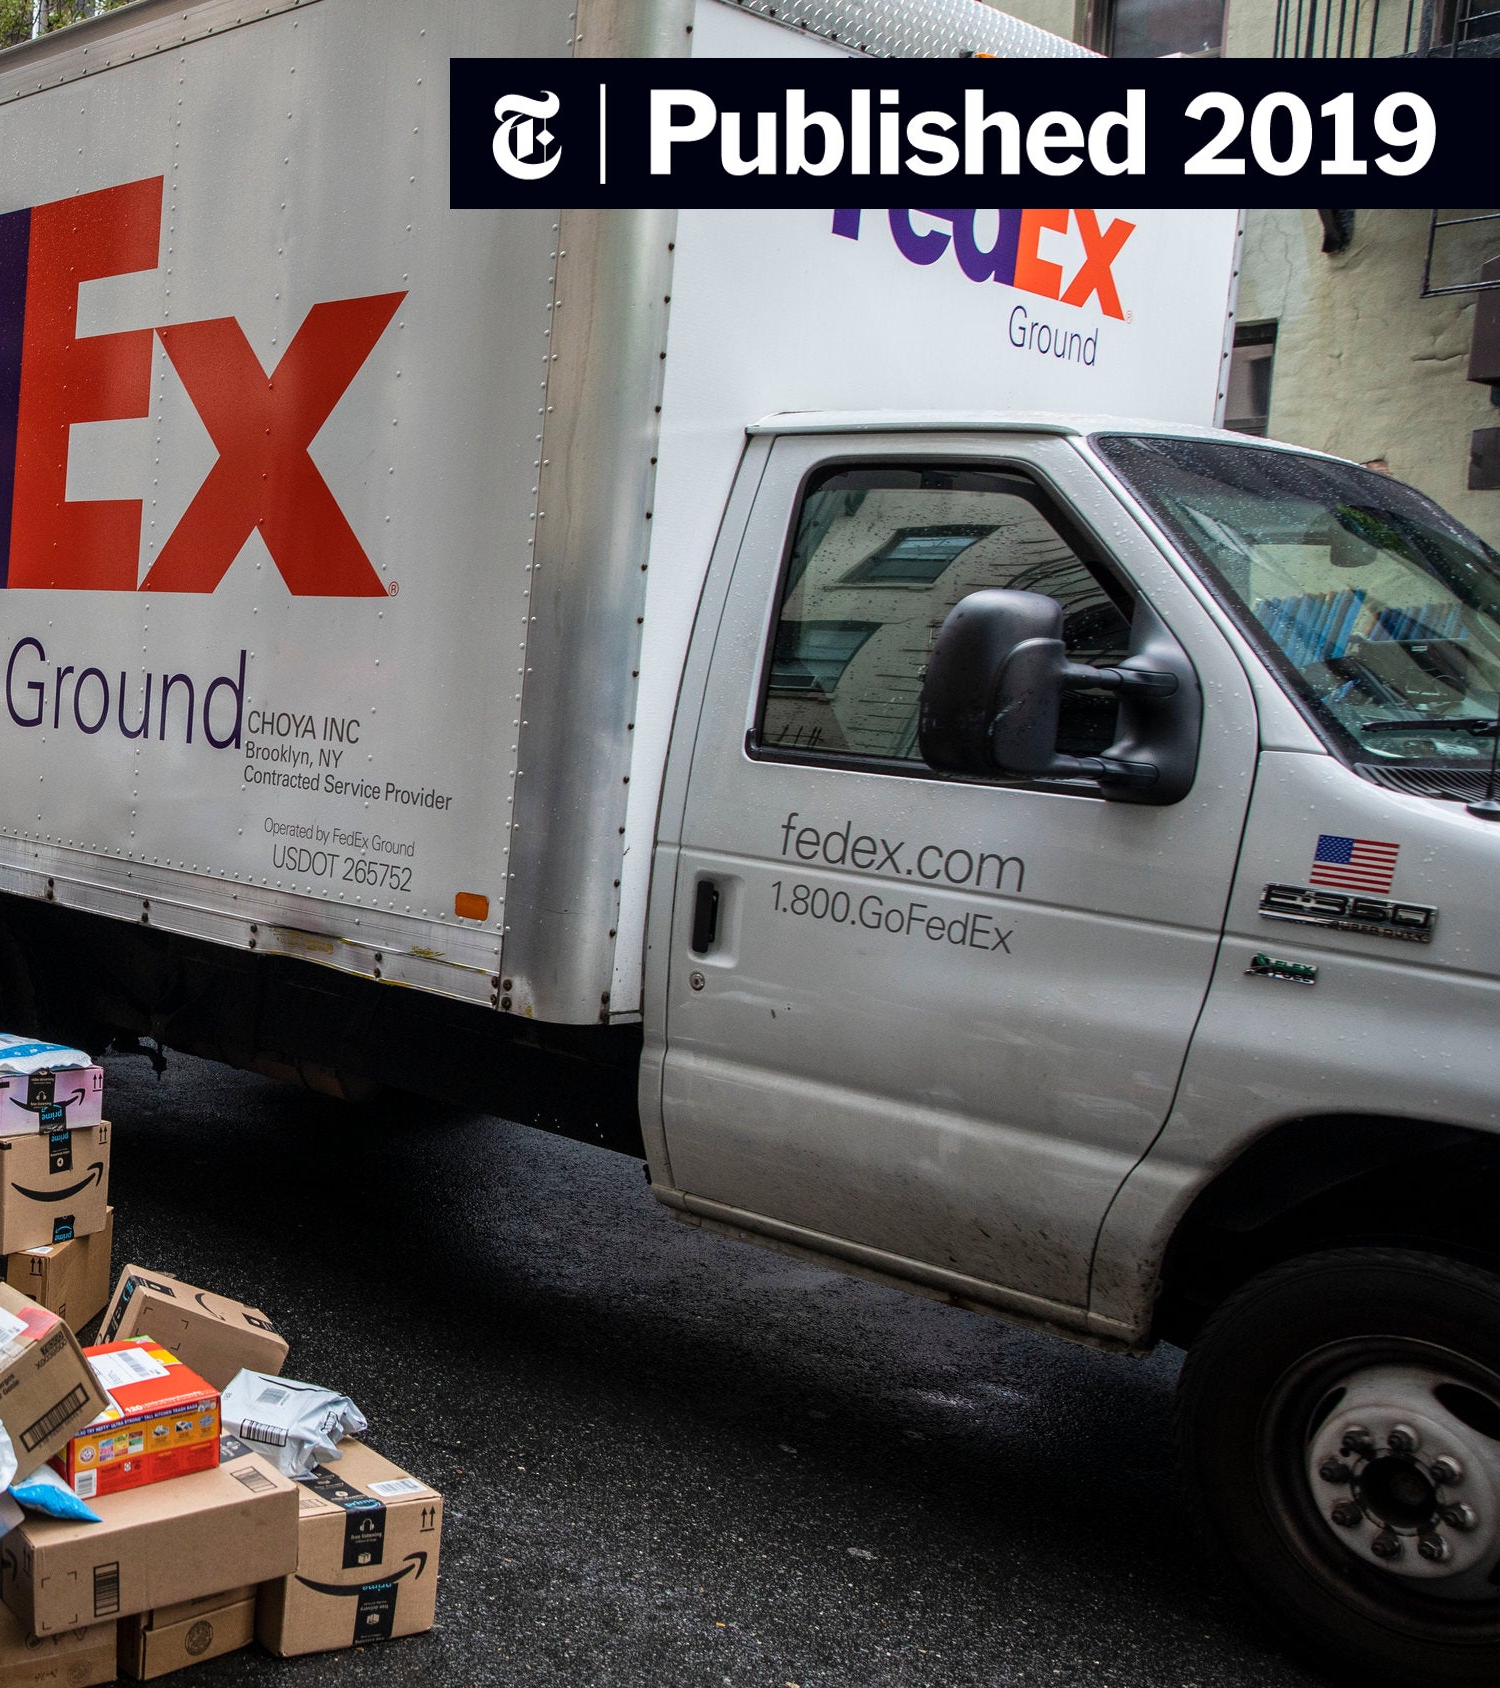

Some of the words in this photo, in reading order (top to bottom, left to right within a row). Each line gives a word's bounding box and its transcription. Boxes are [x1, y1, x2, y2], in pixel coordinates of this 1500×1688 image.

[1009, 305, 1098, 366] Ground
[6, 637, 246, 750] Ground
[247, 710, 316, 740] CHOYA
[323, 717, 361, 744] INC
[245, 741, 314, 768] Brooklyn,
[319, 749, 344, 769] NY
[243, 765, 321, 793] Contracted
[324, 774, 381, 801] Service
[385, 782, 453, 811] Provider
[264, 817, 314, 841] Operated
[315, 825, 330, 845] by
[333, 828, 369, 849] FedEx
[371, 833, 415, 857] Ground
[781, 811, 1026, 892] fedex.com
[272, 843, 340, 879] USDOT
[343, 858, 413, 893] 265752
[771, 880, 1014, 954] 1.800.GoFedEx
[1274, 960, 1313, 974] FLEX
[41, 1107, 63, 1120] prime
[51, 1132, 69, 1143] prime
[54, 1230, 73, 1242] prime
[125, 1405, 143, 1413] 120
[154, 1410, 172, 1418] KITCHEN
[186, 1403, 198, 1411] BAGS
[345, 1498, 379, 1508] prime
[361, 1532, 383, 1540] listening
